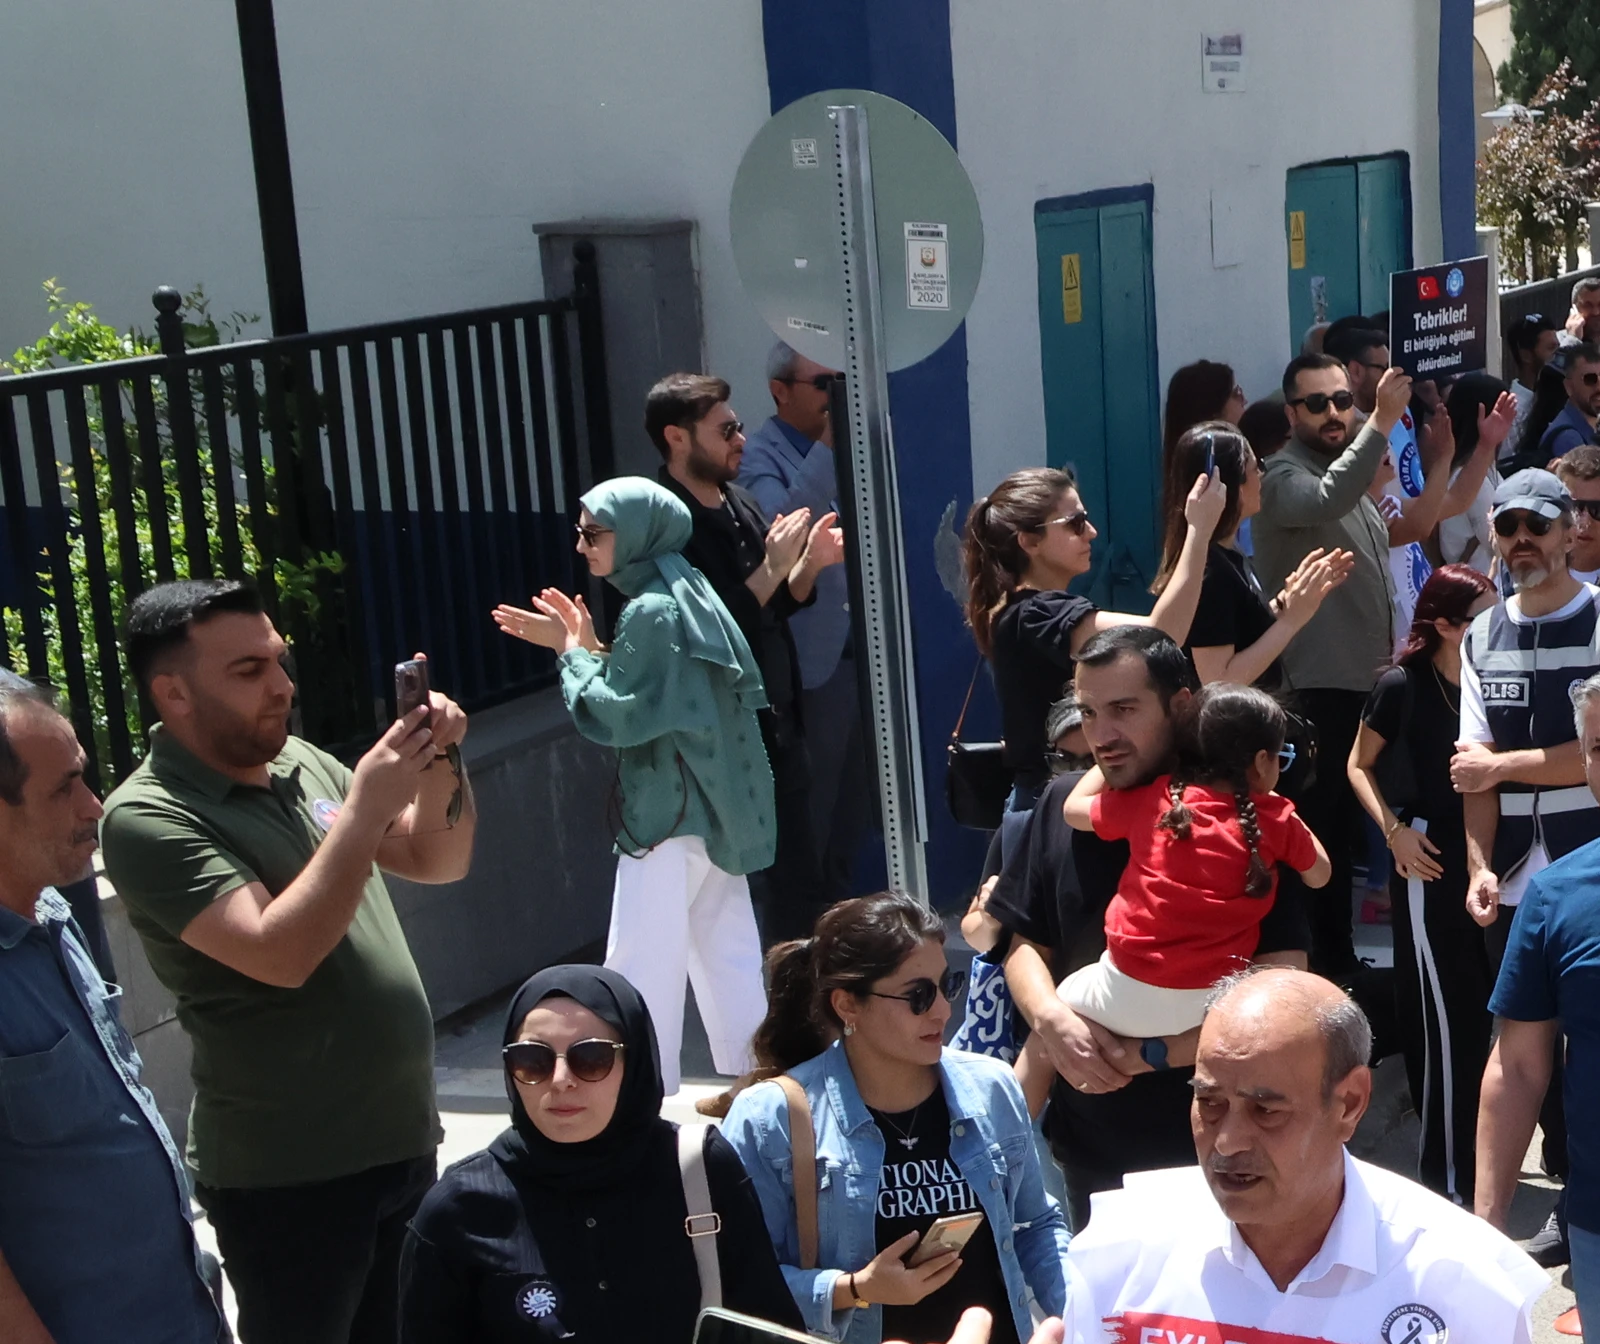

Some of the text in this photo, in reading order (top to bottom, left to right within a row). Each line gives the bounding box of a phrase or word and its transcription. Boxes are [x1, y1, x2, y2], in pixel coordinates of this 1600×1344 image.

[917, 292, 943, 303] 2020
[1413, 303, 1468, 332] Tebrikler!
[1403, 326, 1476, 354] El birliğiyle eğitimi
[1416, 351, 1462, 373] öldürdünüz!
[880, 1158, 966, 1190] TIONA
